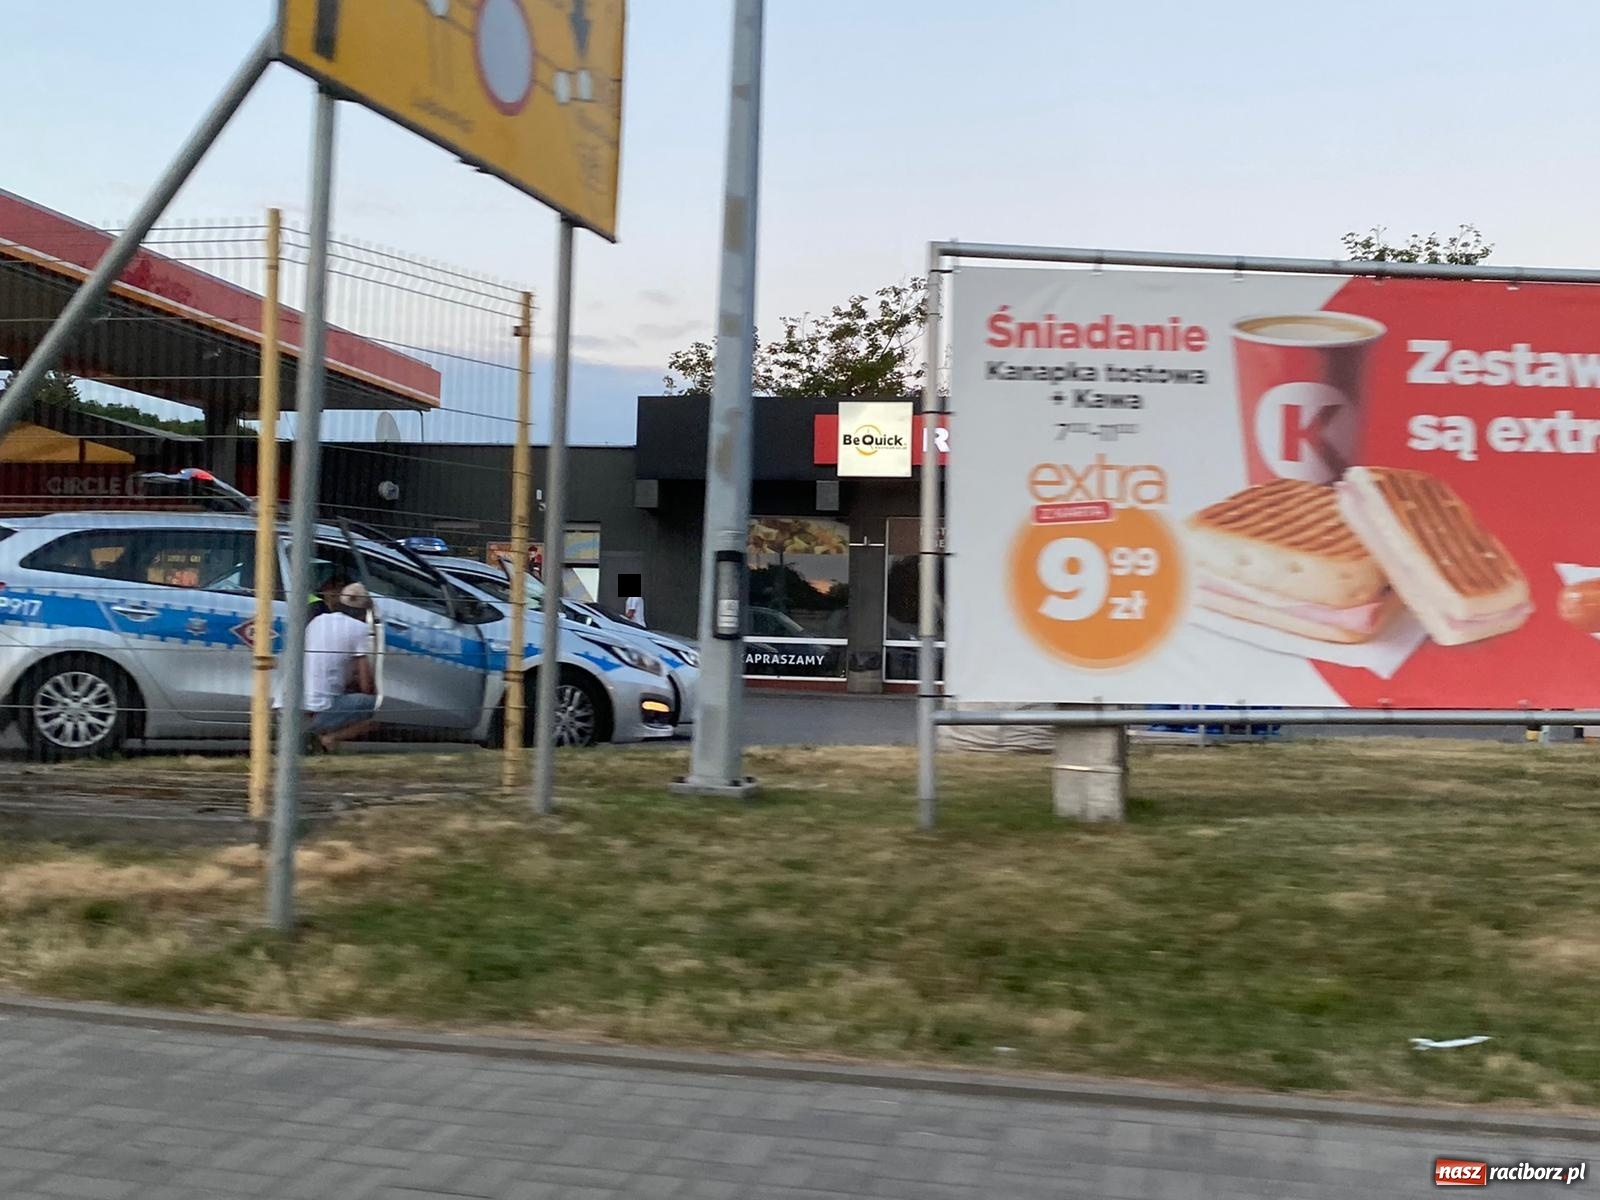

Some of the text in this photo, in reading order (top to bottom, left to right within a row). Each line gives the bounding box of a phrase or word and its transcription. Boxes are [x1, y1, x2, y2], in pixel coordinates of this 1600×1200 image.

[986, 305, 1208, 352] Śniadanie
[985, 361, 1208, 385] Kanapka tostowa
[1072, 389, 1143, 409] Kawa
[1407, 414, 1478, 461] są
[47, 476, 122, 495] CIRCLE
[1028, 453, 1168, 504] extra
[1037, 537, 1159, 621] 9 99 zł
[741, 653, 825, 665] APRASZAMY
